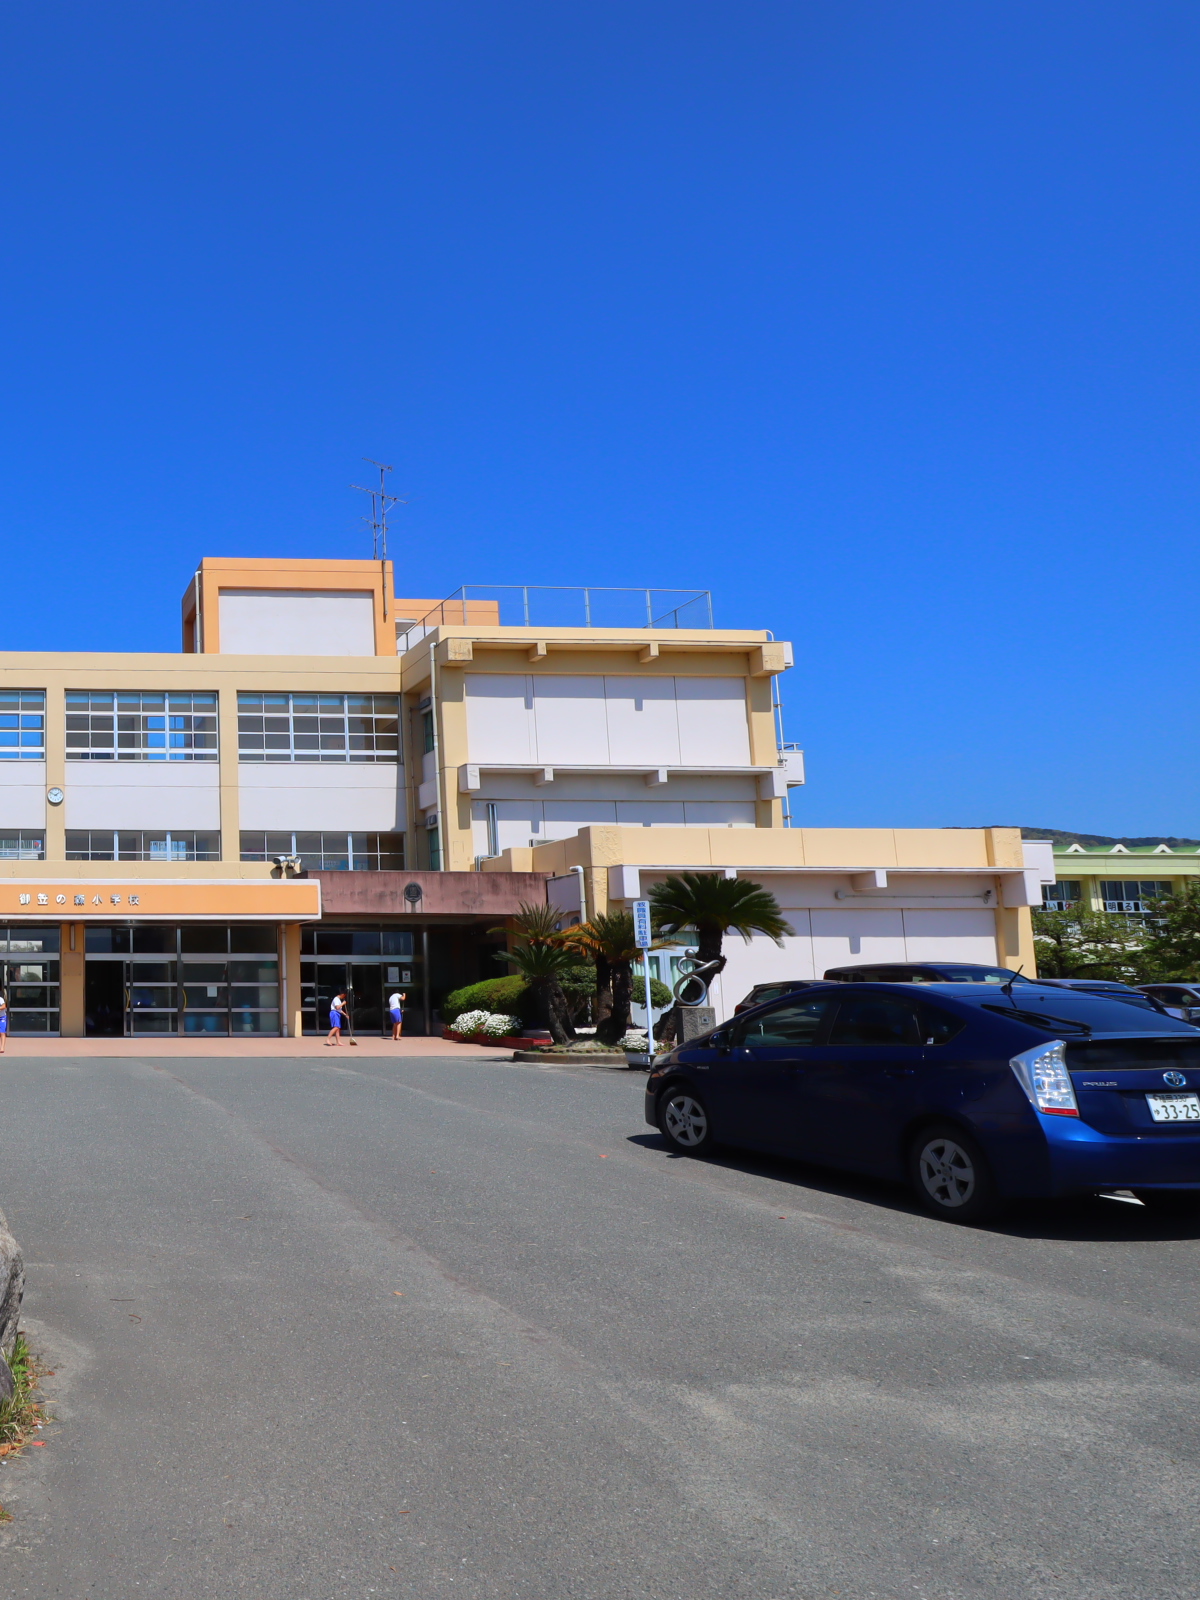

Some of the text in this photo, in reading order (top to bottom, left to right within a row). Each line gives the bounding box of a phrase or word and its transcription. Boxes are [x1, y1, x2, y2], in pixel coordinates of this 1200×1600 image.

[19, 893, 139, 906] 御笠の森小学校
[1161, 1104, 1200, 1119] 33-25
